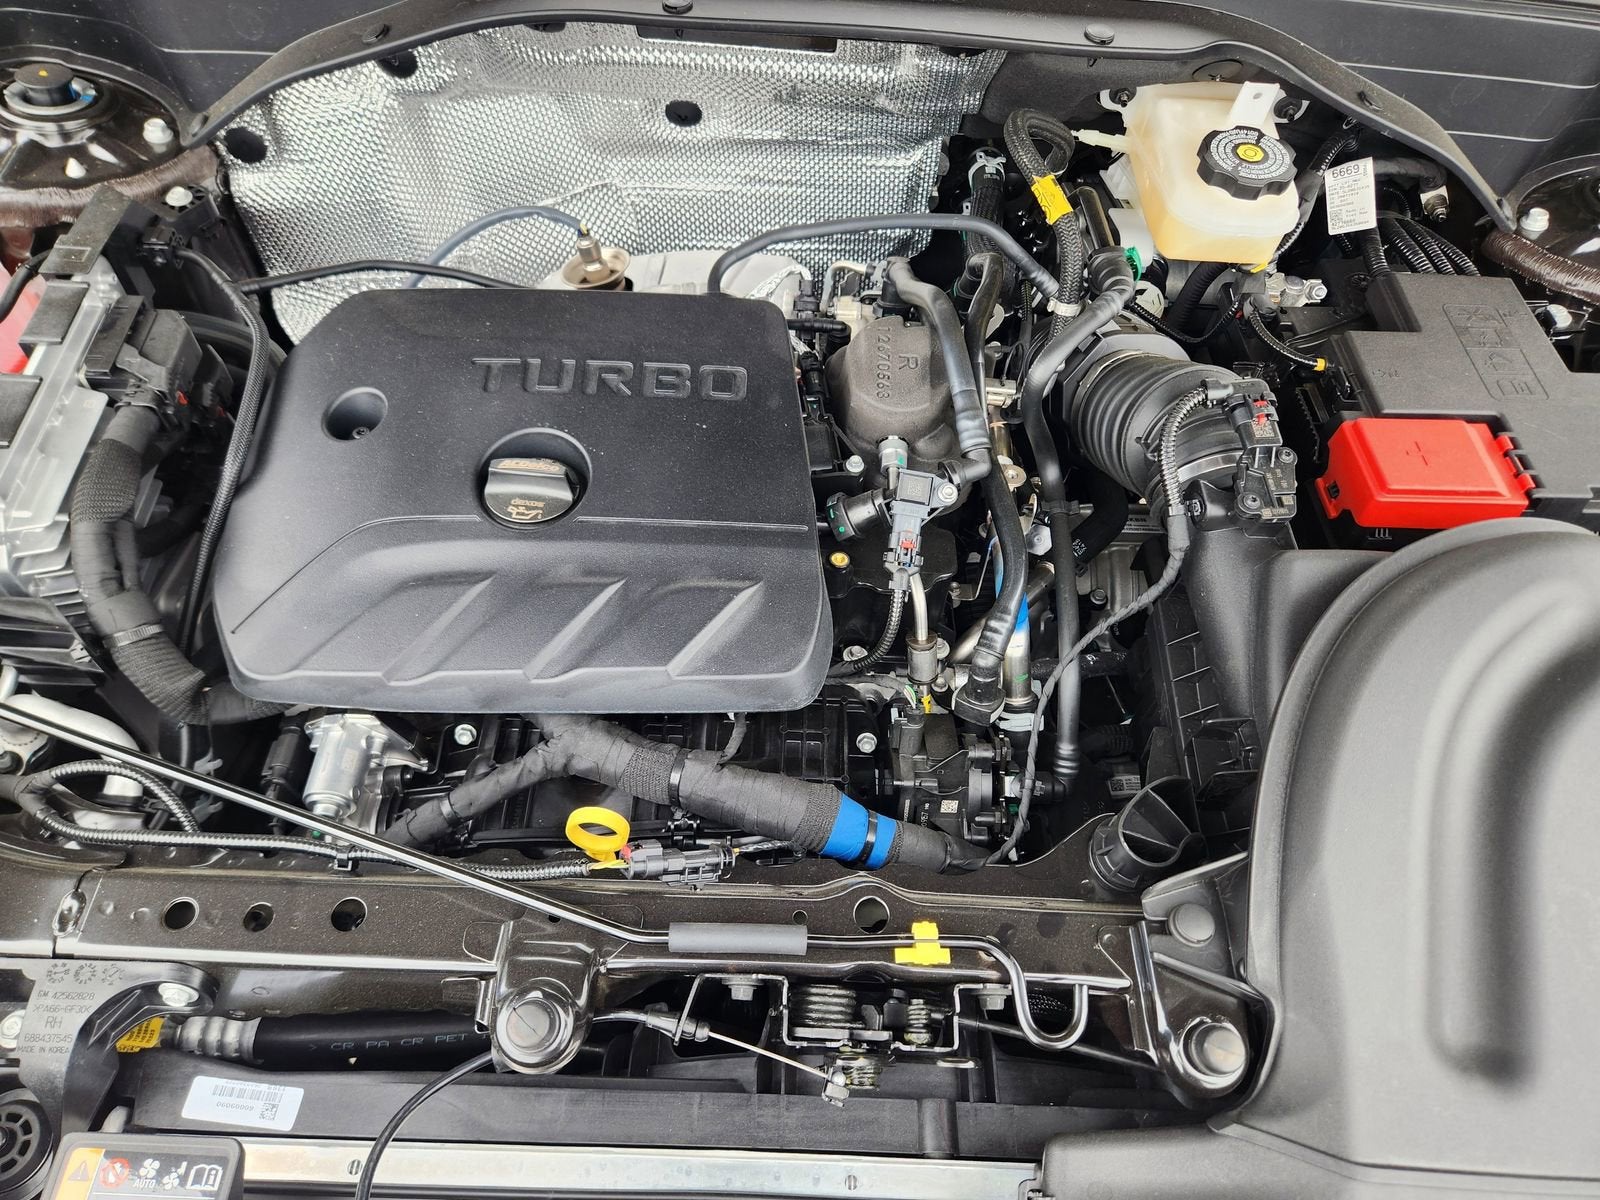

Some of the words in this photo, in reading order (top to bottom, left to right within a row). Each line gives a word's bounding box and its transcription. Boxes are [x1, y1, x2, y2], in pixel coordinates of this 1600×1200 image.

[1332, 164, 1360, 178] 6669
[898, 353, 920, 370] R
[471, 357, 749, 400] TURBO
[37, 990, 49, 998] GM
[51, 991, 96, 1000] 42562828
[44, 1015, 63, 1029] RH
[331, 1042, 355, 1050] CR
[366, 1040, 390, 1049] PA
[400, 1037, 424, 1046] CR
[434, 1033, 469, 1044] PET
[17, 1045, 36, 1054] MADE
[38, 1046, 46, 1054] IN
[48, 1046, 71, 1055] KOREA
[132, 1178, 156, 1189] AUTO
